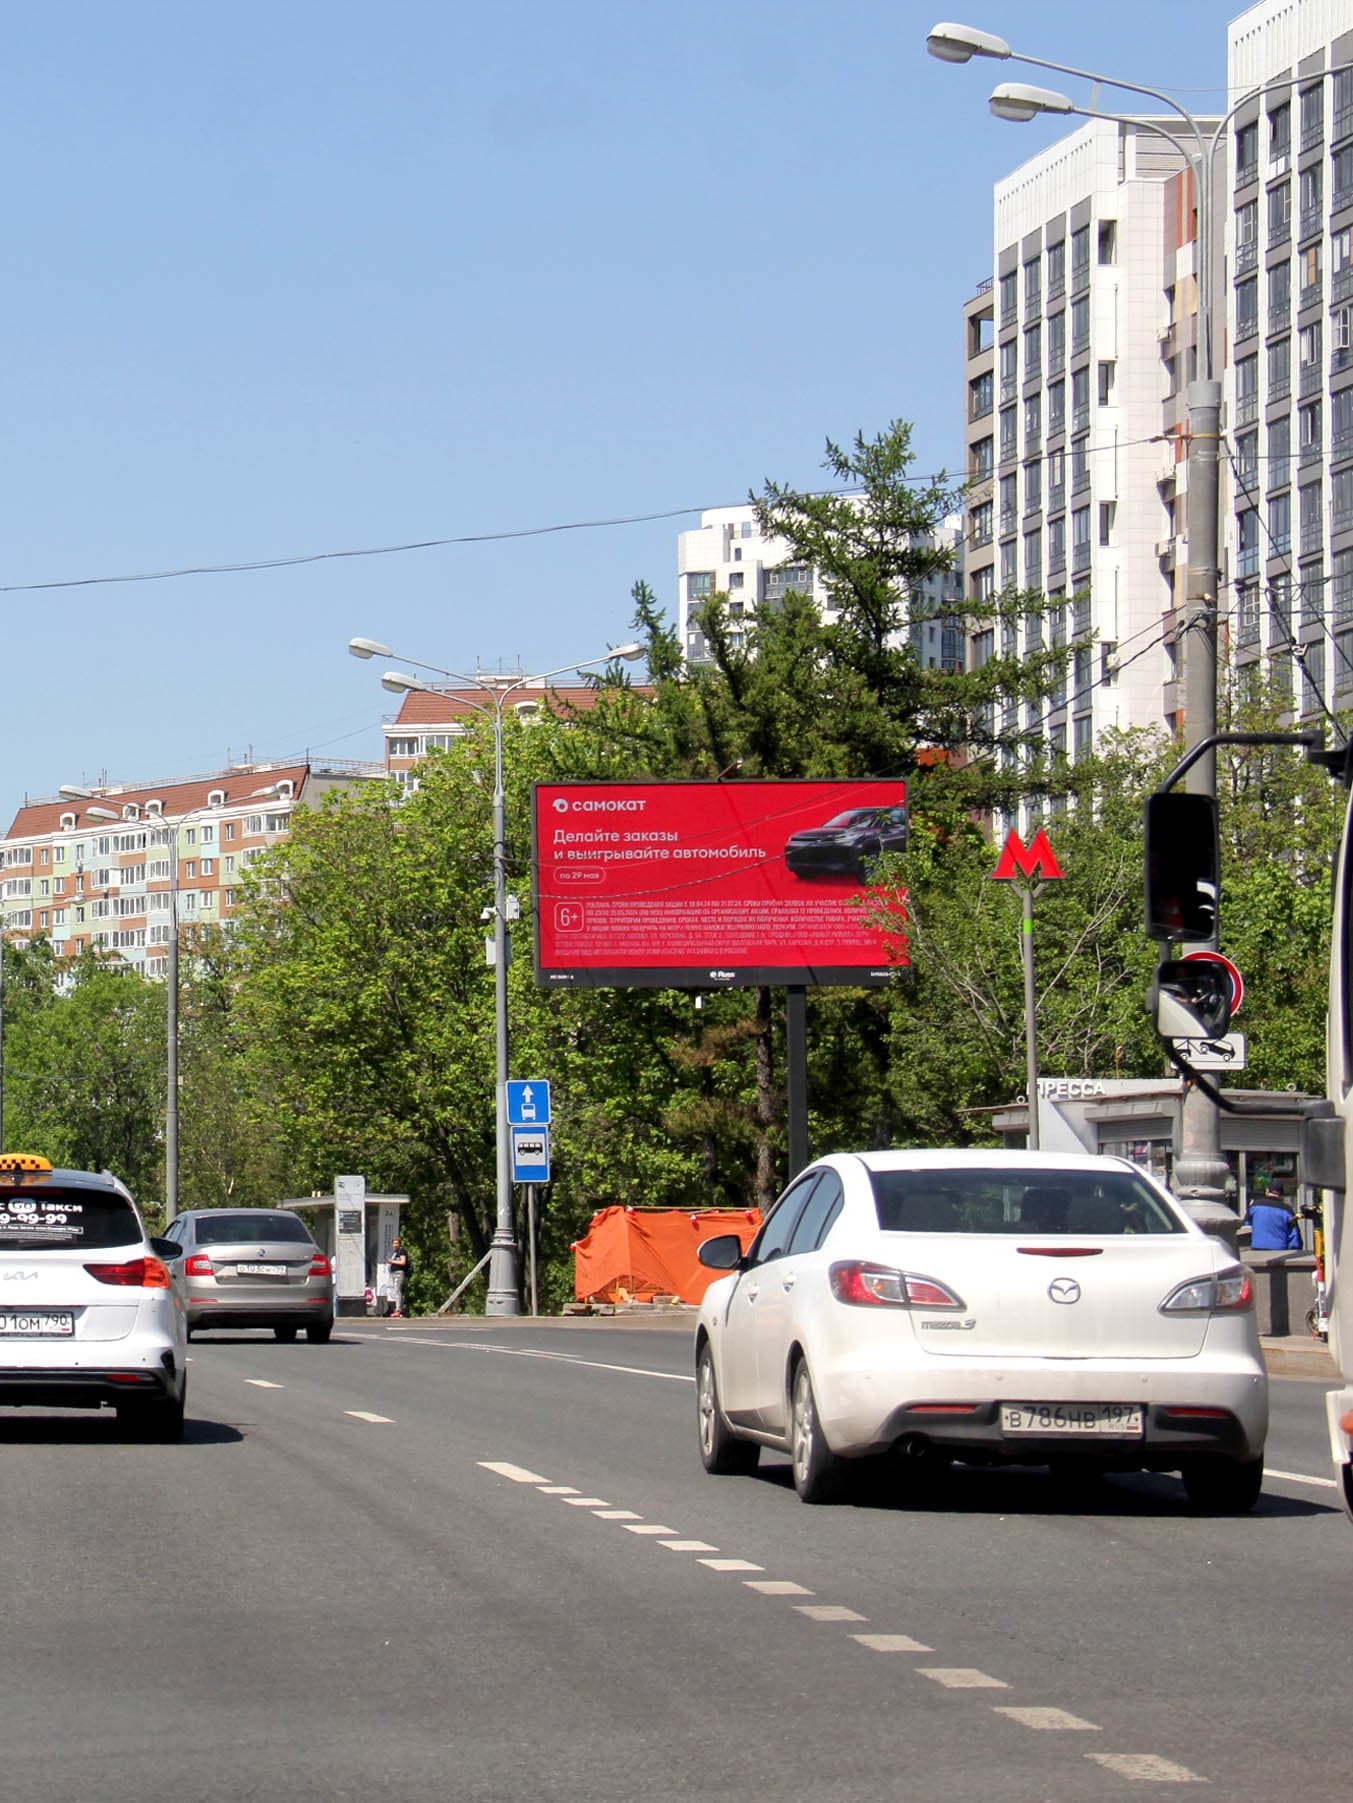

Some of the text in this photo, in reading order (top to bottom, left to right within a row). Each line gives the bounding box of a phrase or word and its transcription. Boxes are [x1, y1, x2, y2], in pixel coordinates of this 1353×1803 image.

[572, 799, 646, 812] самокат
[553, 828, 679, 844] Делайте заказы
[554, 845, 766, 863] и выигрывайте автомобиль
[560, 908, 579, 927] 6+
